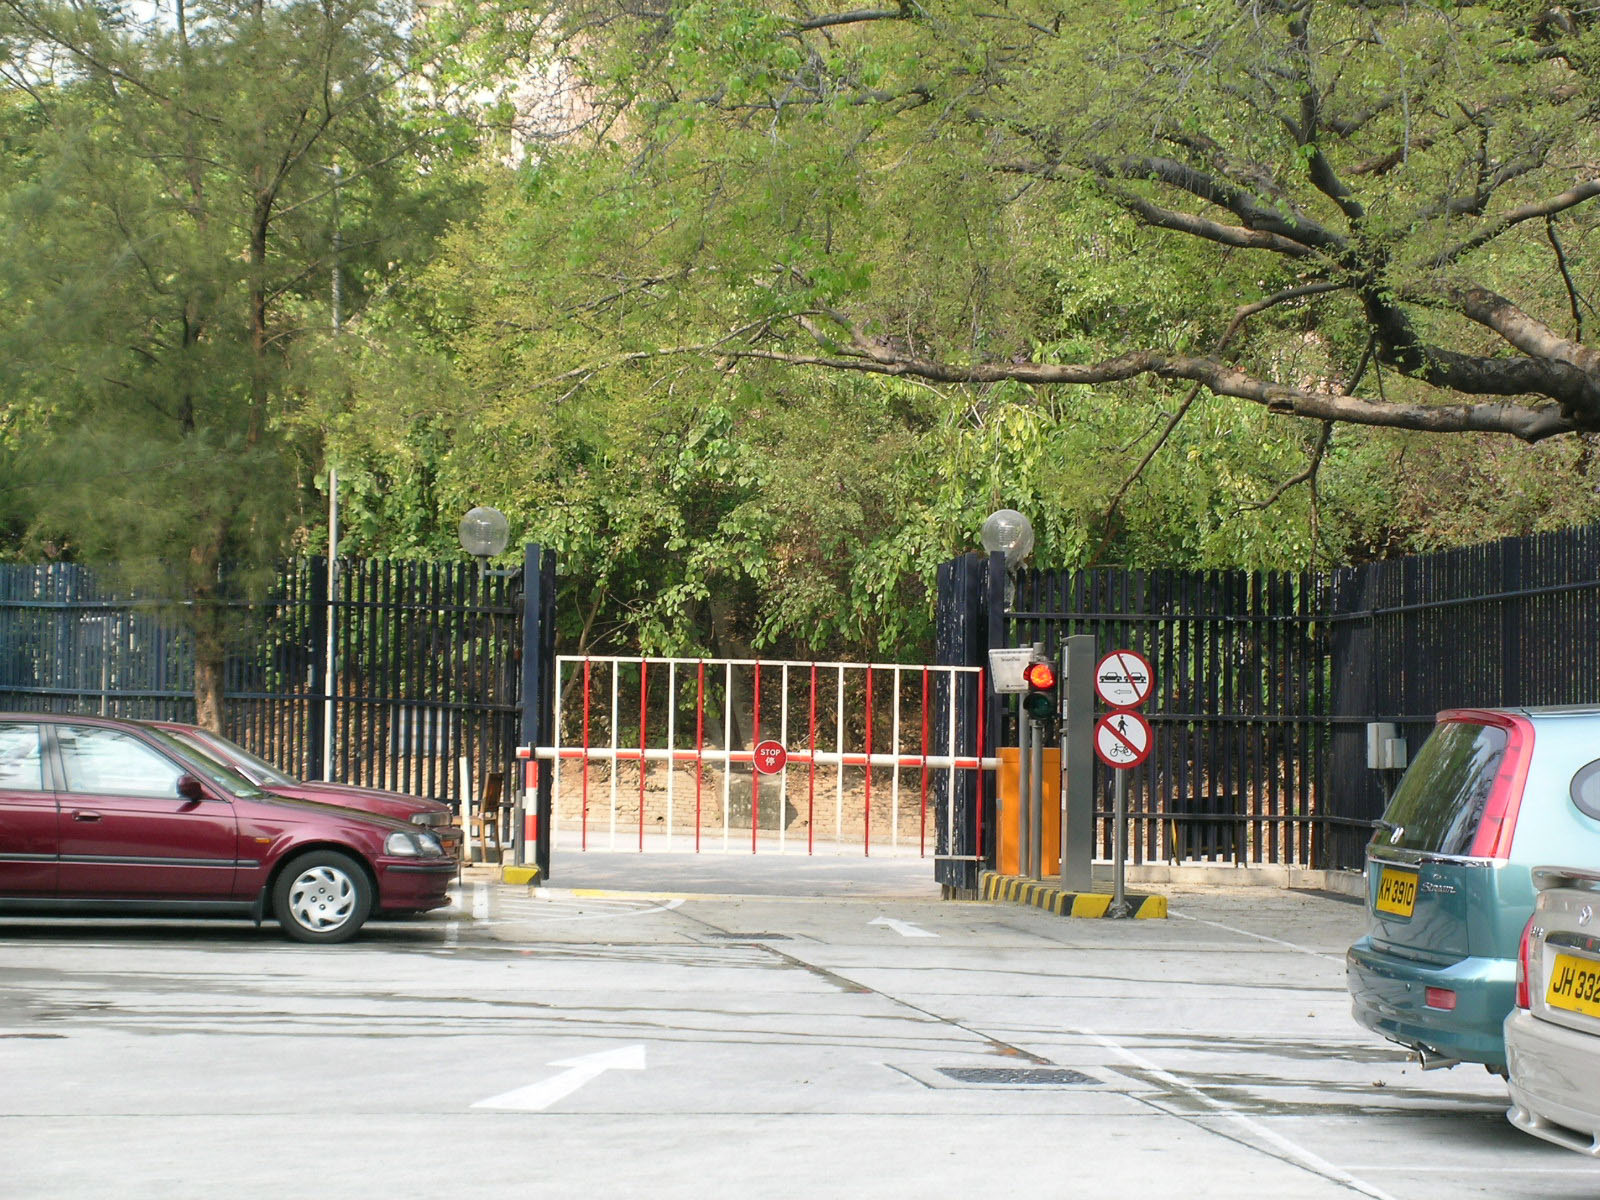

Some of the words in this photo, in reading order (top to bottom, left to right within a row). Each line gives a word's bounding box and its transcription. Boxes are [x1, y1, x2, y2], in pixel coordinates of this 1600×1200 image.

[760, 748, 781, 756] STOP
[1379, 877, 1393, 902] KH
[1391, 880, 1415, 906] 3910
[1553, 966, 1576, 997] JH
